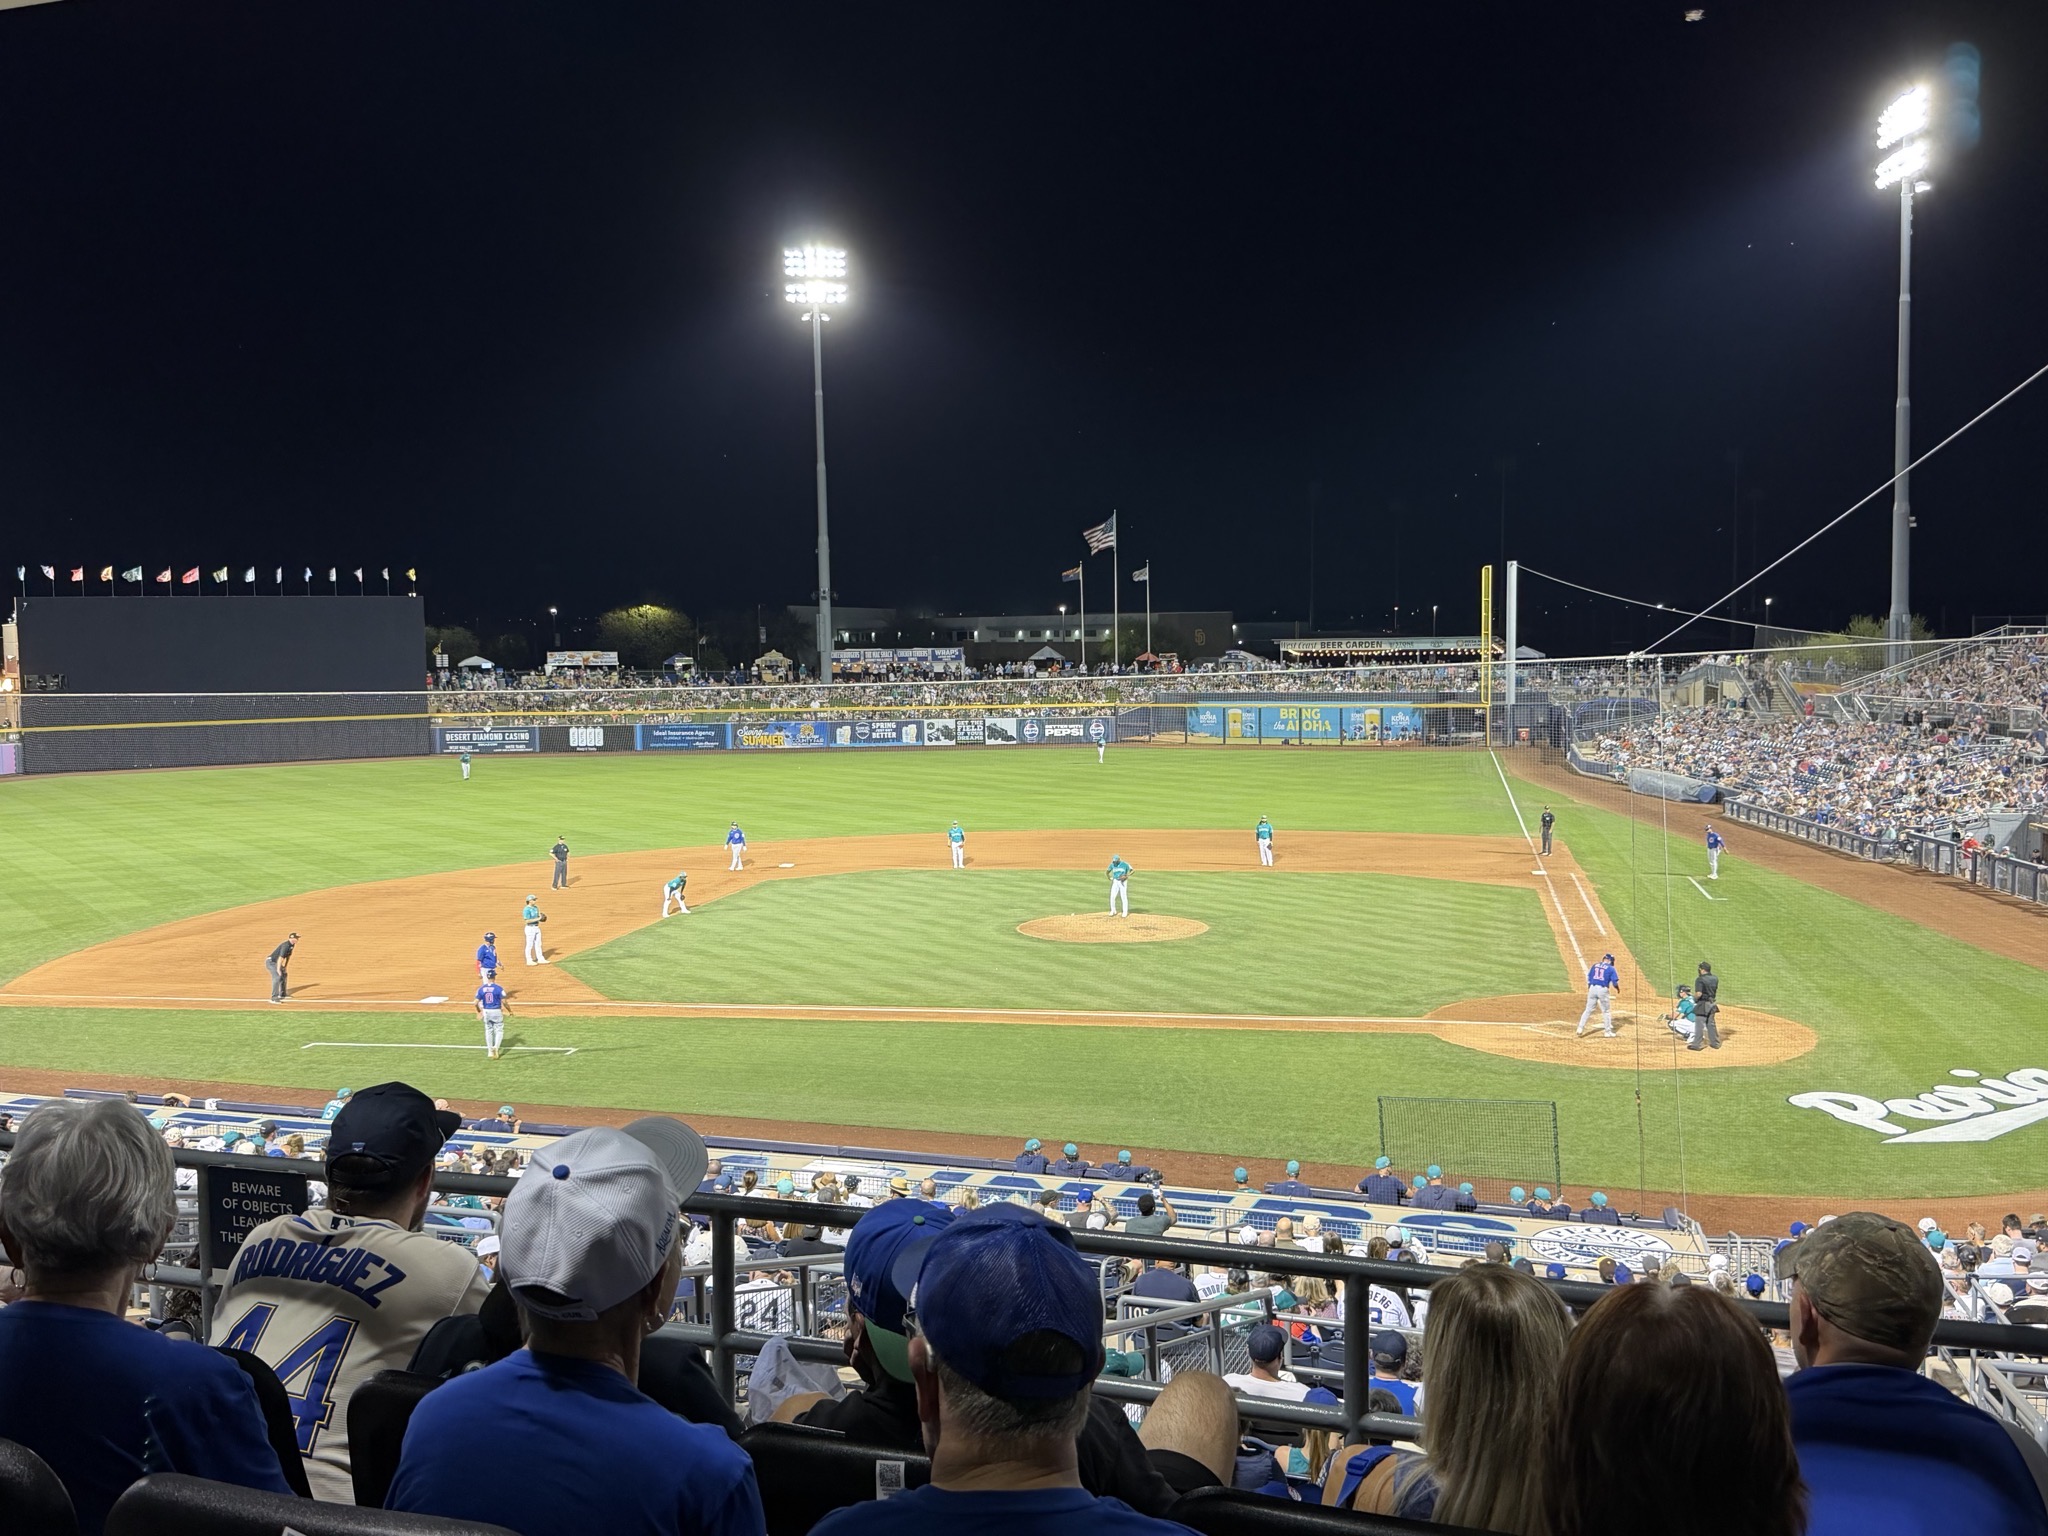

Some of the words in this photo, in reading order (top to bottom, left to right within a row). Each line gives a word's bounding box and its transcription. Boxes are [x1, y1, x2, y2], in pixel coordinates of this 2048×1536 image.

[1320, 641, 1343, 649] BEER
[1345, 641, 1383, 649] GARDEN
[935, 648, 959, 656] WRAPS
[1279, 707, 1321, 720] BRNG
[737, 726, 763, 739] Swing
[871, 722, 897, 730] SPRING
[1044, 728, 1084, 737] PEPSI
[1273, 721, 1286, 731] the
[1286, 720, 1332, 732] ALOHA
[445, 733, 471, 742] DESERT
[472, 733, 503, 741] DIAMOND
[504, 732, 530, 741] CASINO
[693, 730, 716, 738] Agency
[742, 734, 784, 746] SUMMER
[1593, 967, 1605, 981] 11
[325, 1106, 337, 1119] 5
[231, 1181, 282, 1198] BEWARE
[222, 1197, 239, 1210] OF
[241, 1199, 294, 1215] OBJECTS
[220, 1230, 245, 1245] THE
[1546, 1226, 1660, 1247] PEORIA
[740, 1297, 779, 1329] 24
[1128, 1306, 1150, 1320] 105
